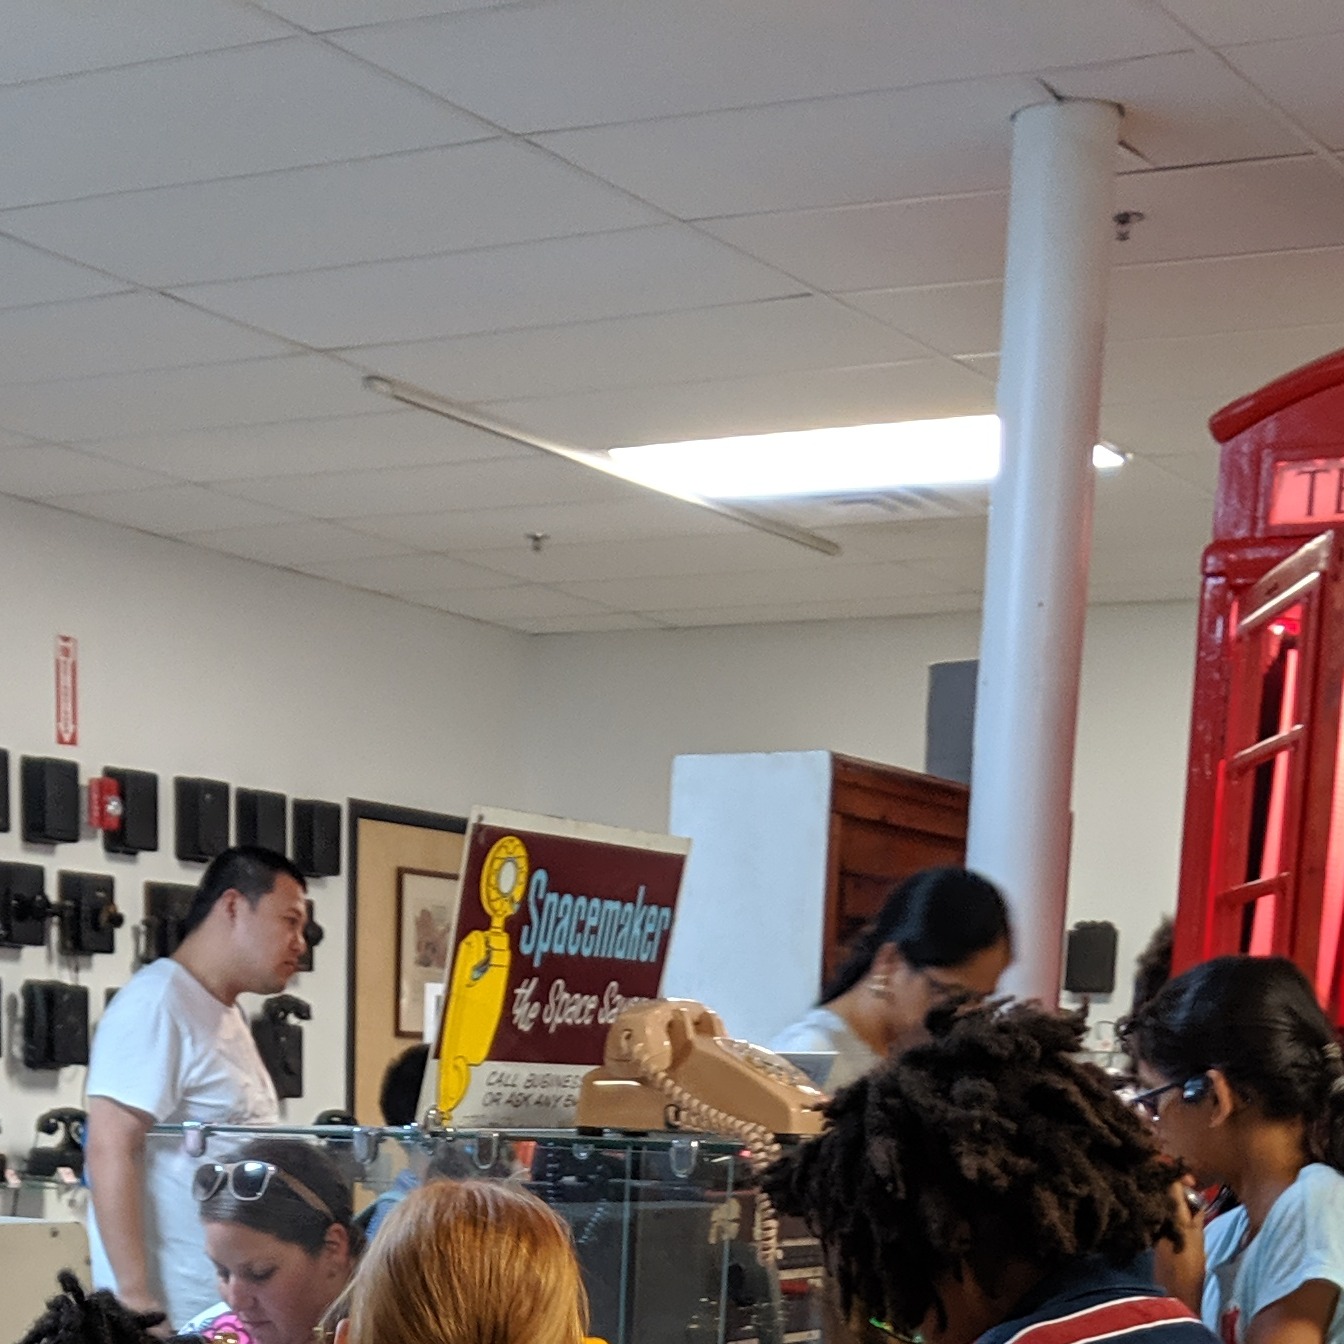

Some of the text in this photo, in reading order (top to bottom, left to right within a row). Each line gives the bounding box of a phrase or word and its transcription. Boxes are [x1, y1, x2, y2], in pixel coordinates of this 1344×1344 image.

[518, 868, 672, 968] Spacemaker
[512, 977, 542, 1032] the
[542, 978, 600, 1034] Space
[486, 1071, 519, 1088] CALL
